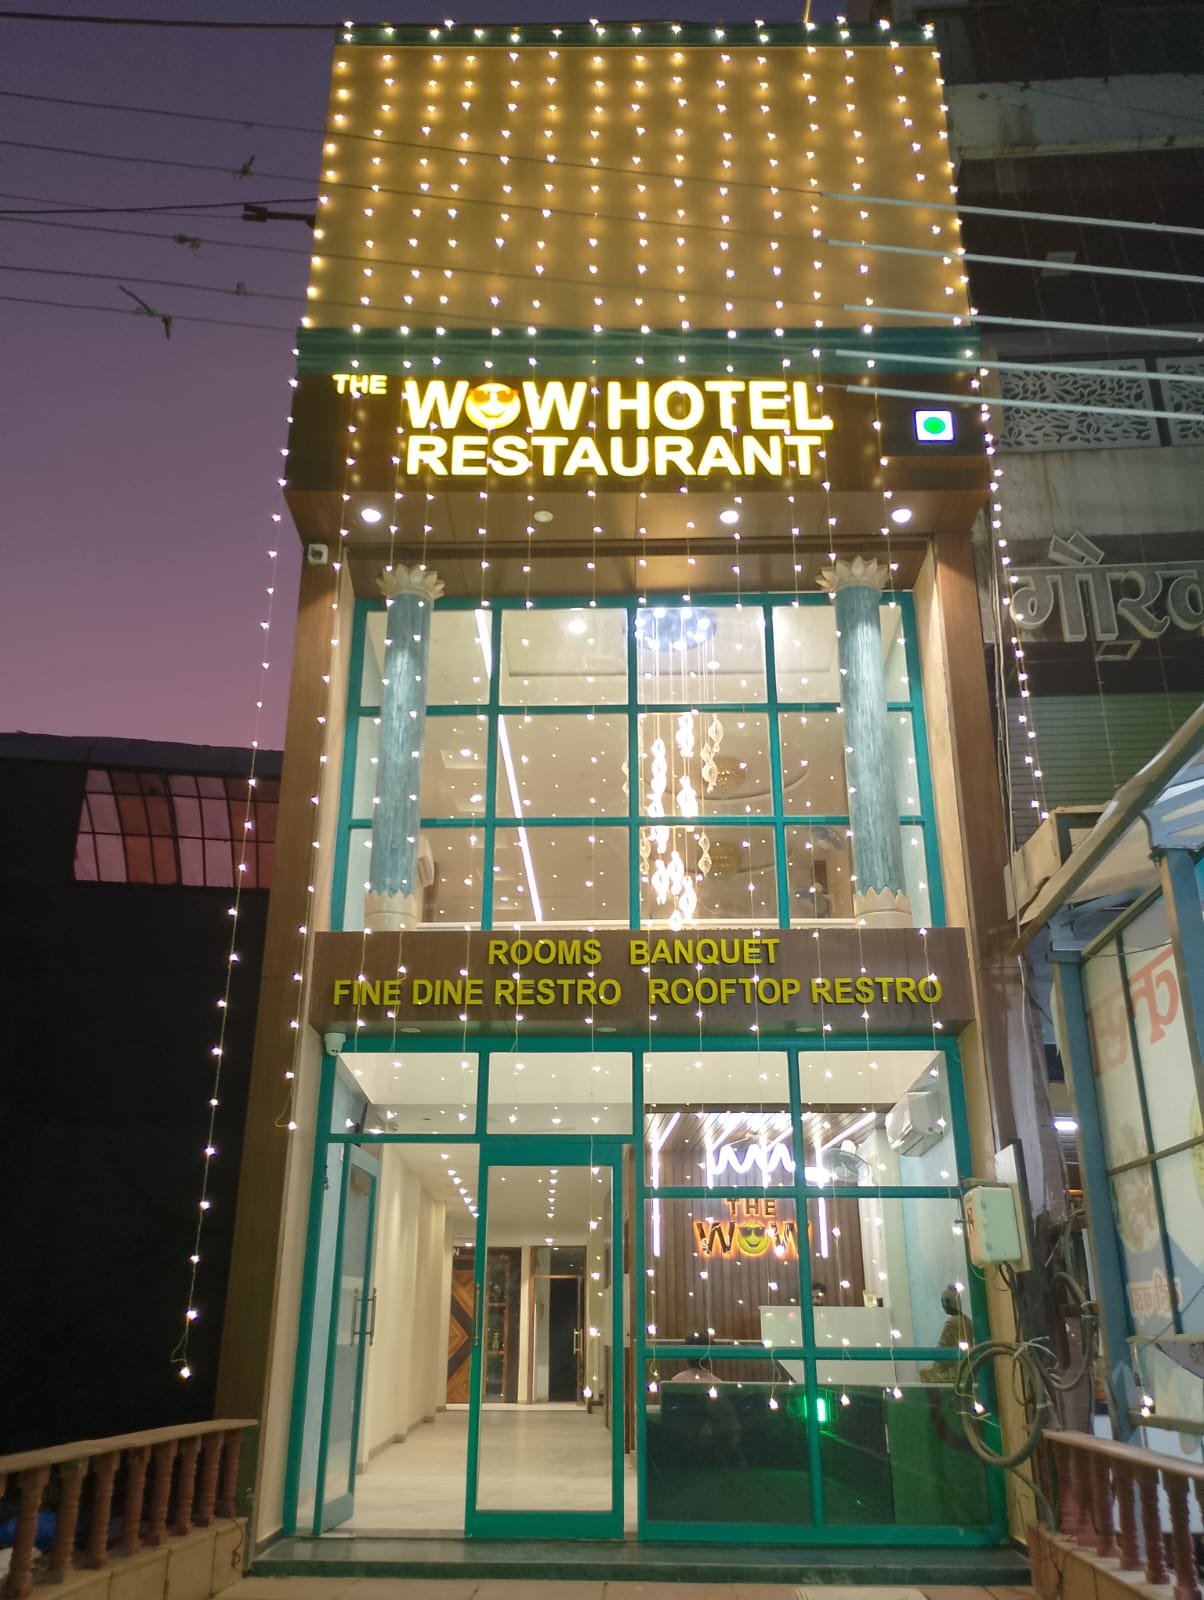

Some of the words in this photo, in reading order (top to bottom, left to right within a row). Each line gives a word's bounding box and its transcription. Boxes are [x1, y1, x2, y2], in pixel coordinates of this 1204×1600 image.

[332, 373, 388, 395] THE
[404, 380, 588, 430] WOW
[607, 380, 834, 431] HOTEL
[406, 435, 822, 477] RESTAURANT
[488, 939, 602, 965] ROOMS
[629, 938, 780, 965] BANQUET
[333, 979, 402, 1006] FINE
[412, 979, 485, 1006] DINE
[494, 979, 622, 1006] RESTRO
[650, 978, 801, 1005] ROOFTOP
[811, 977, 943, 1004] RESTRO
[726, 1197, 777, 1216] THE
